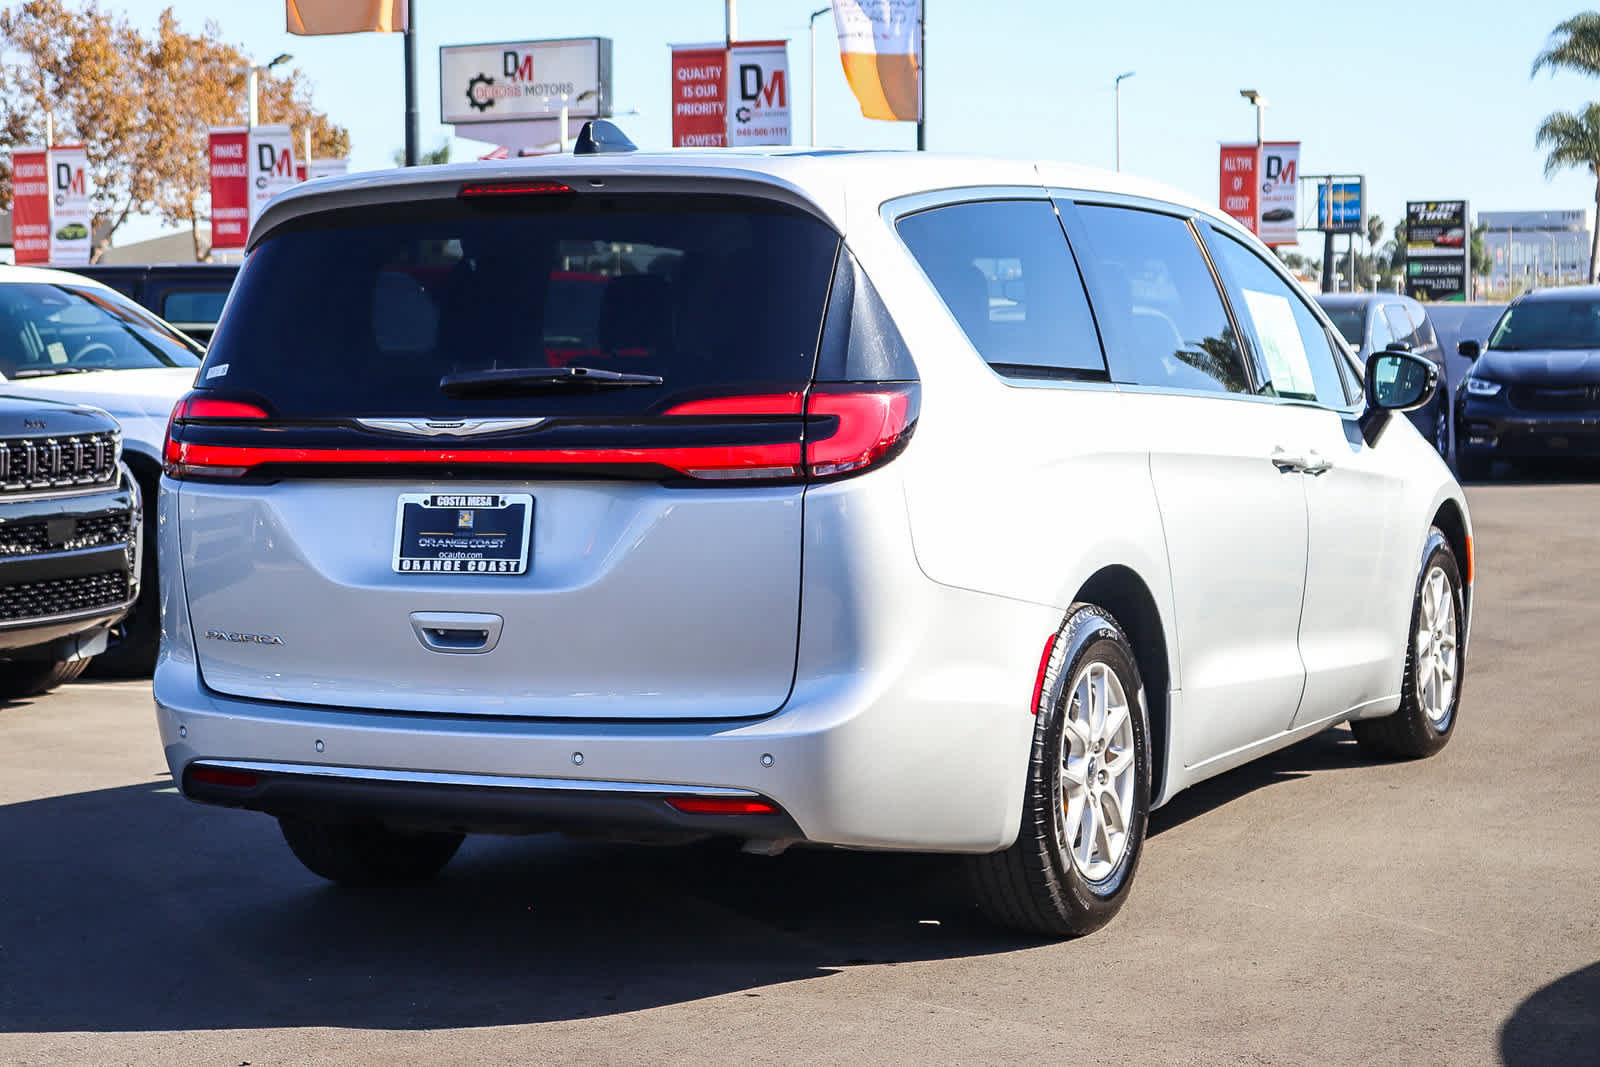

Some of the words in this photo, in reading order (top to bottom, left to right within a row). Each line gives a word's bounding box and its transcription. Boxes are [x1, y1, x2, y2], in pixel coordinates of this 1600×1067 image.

[503, 51, 534, 82] DM
[677, 65, 723, 81] QUALITY
[525, 82, 574, 97] MOTORS
[683, 84, 693, 97] IS
[695, 84, 718, 97] OUR
[739, 63, 787, 108] DM
[676, 102, 725, 116] PRIORITY
[681, 134, 724, 146] LOWEST
[258, 143, 293, 177] DM
[1236, 156, 1253, 171] TYPE
[1266, 155, 1297, 184] DM
[57, 163, 86, 195] DM
[1233, 176, 1243, 191] OF
[1226, 196, 1250, 211] CREDIT
[436, 495, 467, 507] COSTA
[467, 496, 492, 507] MESA
[418, 538, 468, 548] ORANGE
[469, 539, 506, 549] COAST
[438, 551, 483, 560] ocauto.com
[402, 560, 461, 571] ORANGE
[467, 561, 518, 572] COAST
[204, 630, 286, 646] PACIFICA
